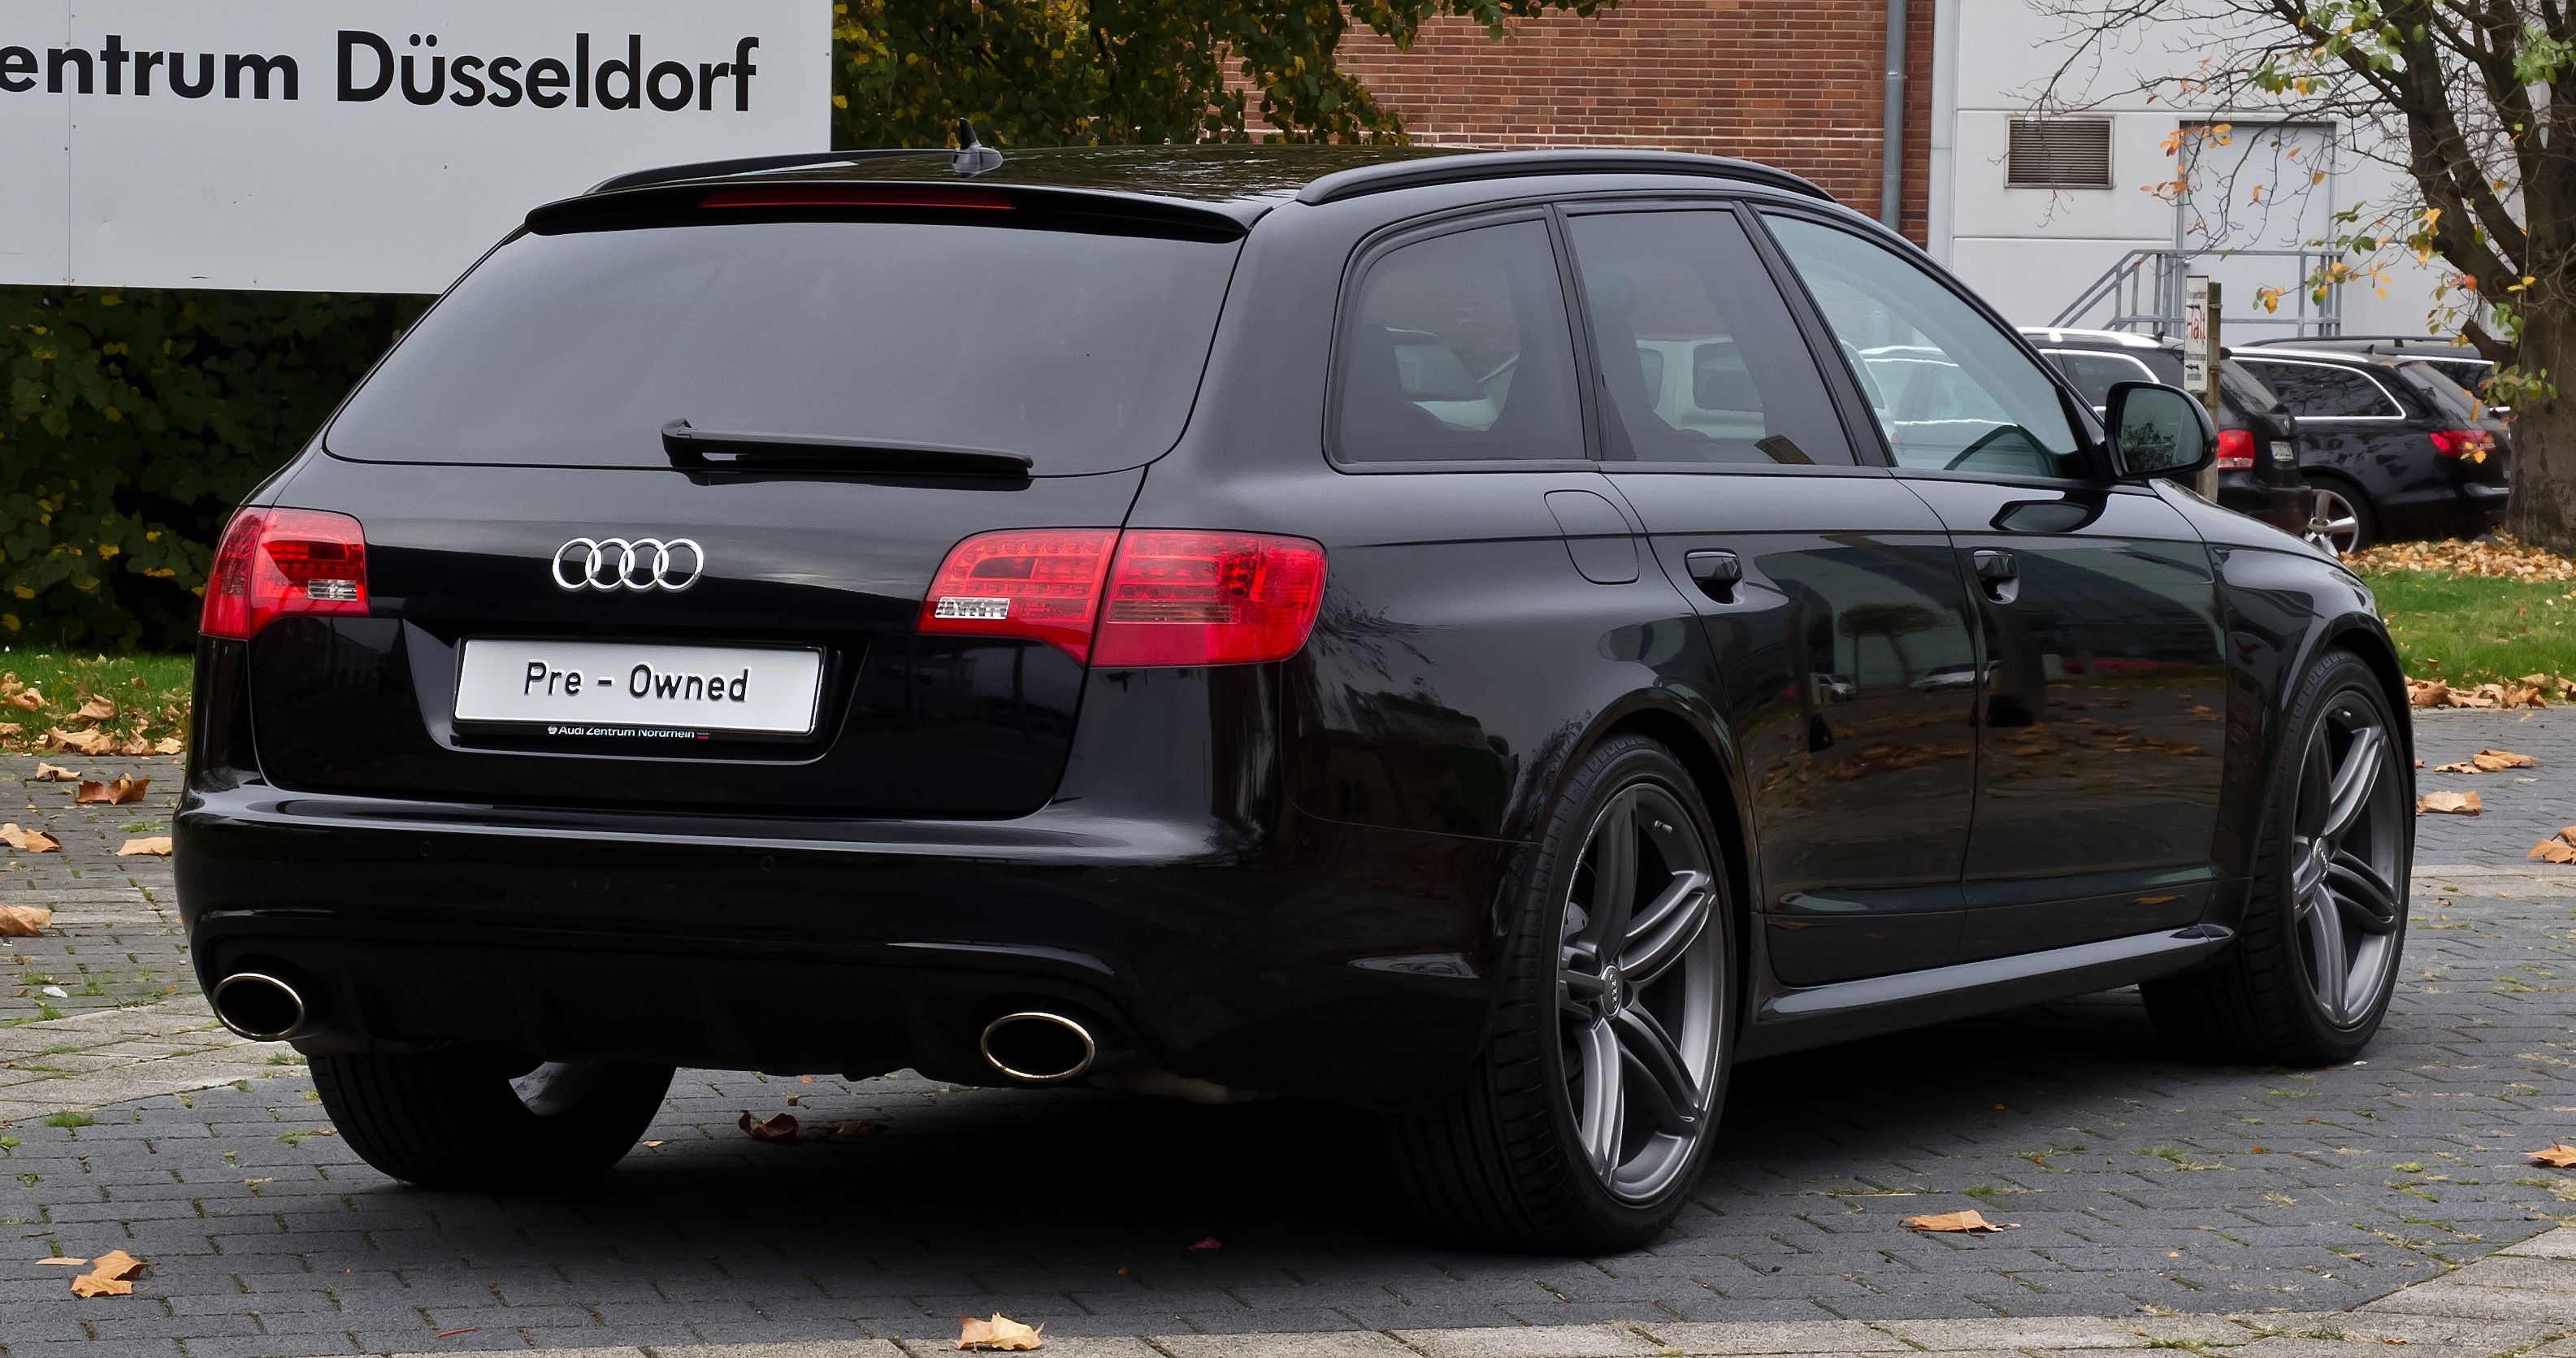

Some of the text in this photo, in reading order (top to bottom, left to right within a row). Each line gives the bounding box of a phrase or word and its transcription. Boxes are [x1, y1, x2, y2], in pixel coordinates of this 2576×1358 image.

[0, 29, 760, 112] entrum Düsseldorf
[2185, 309, 2206, 341] Halt
[524, 661, 583, 696] Pre
[628, 663, 750, 703] Owned
[558, 726, 584, 735] Audi
[586, 727, 635, 737] Zentrum
